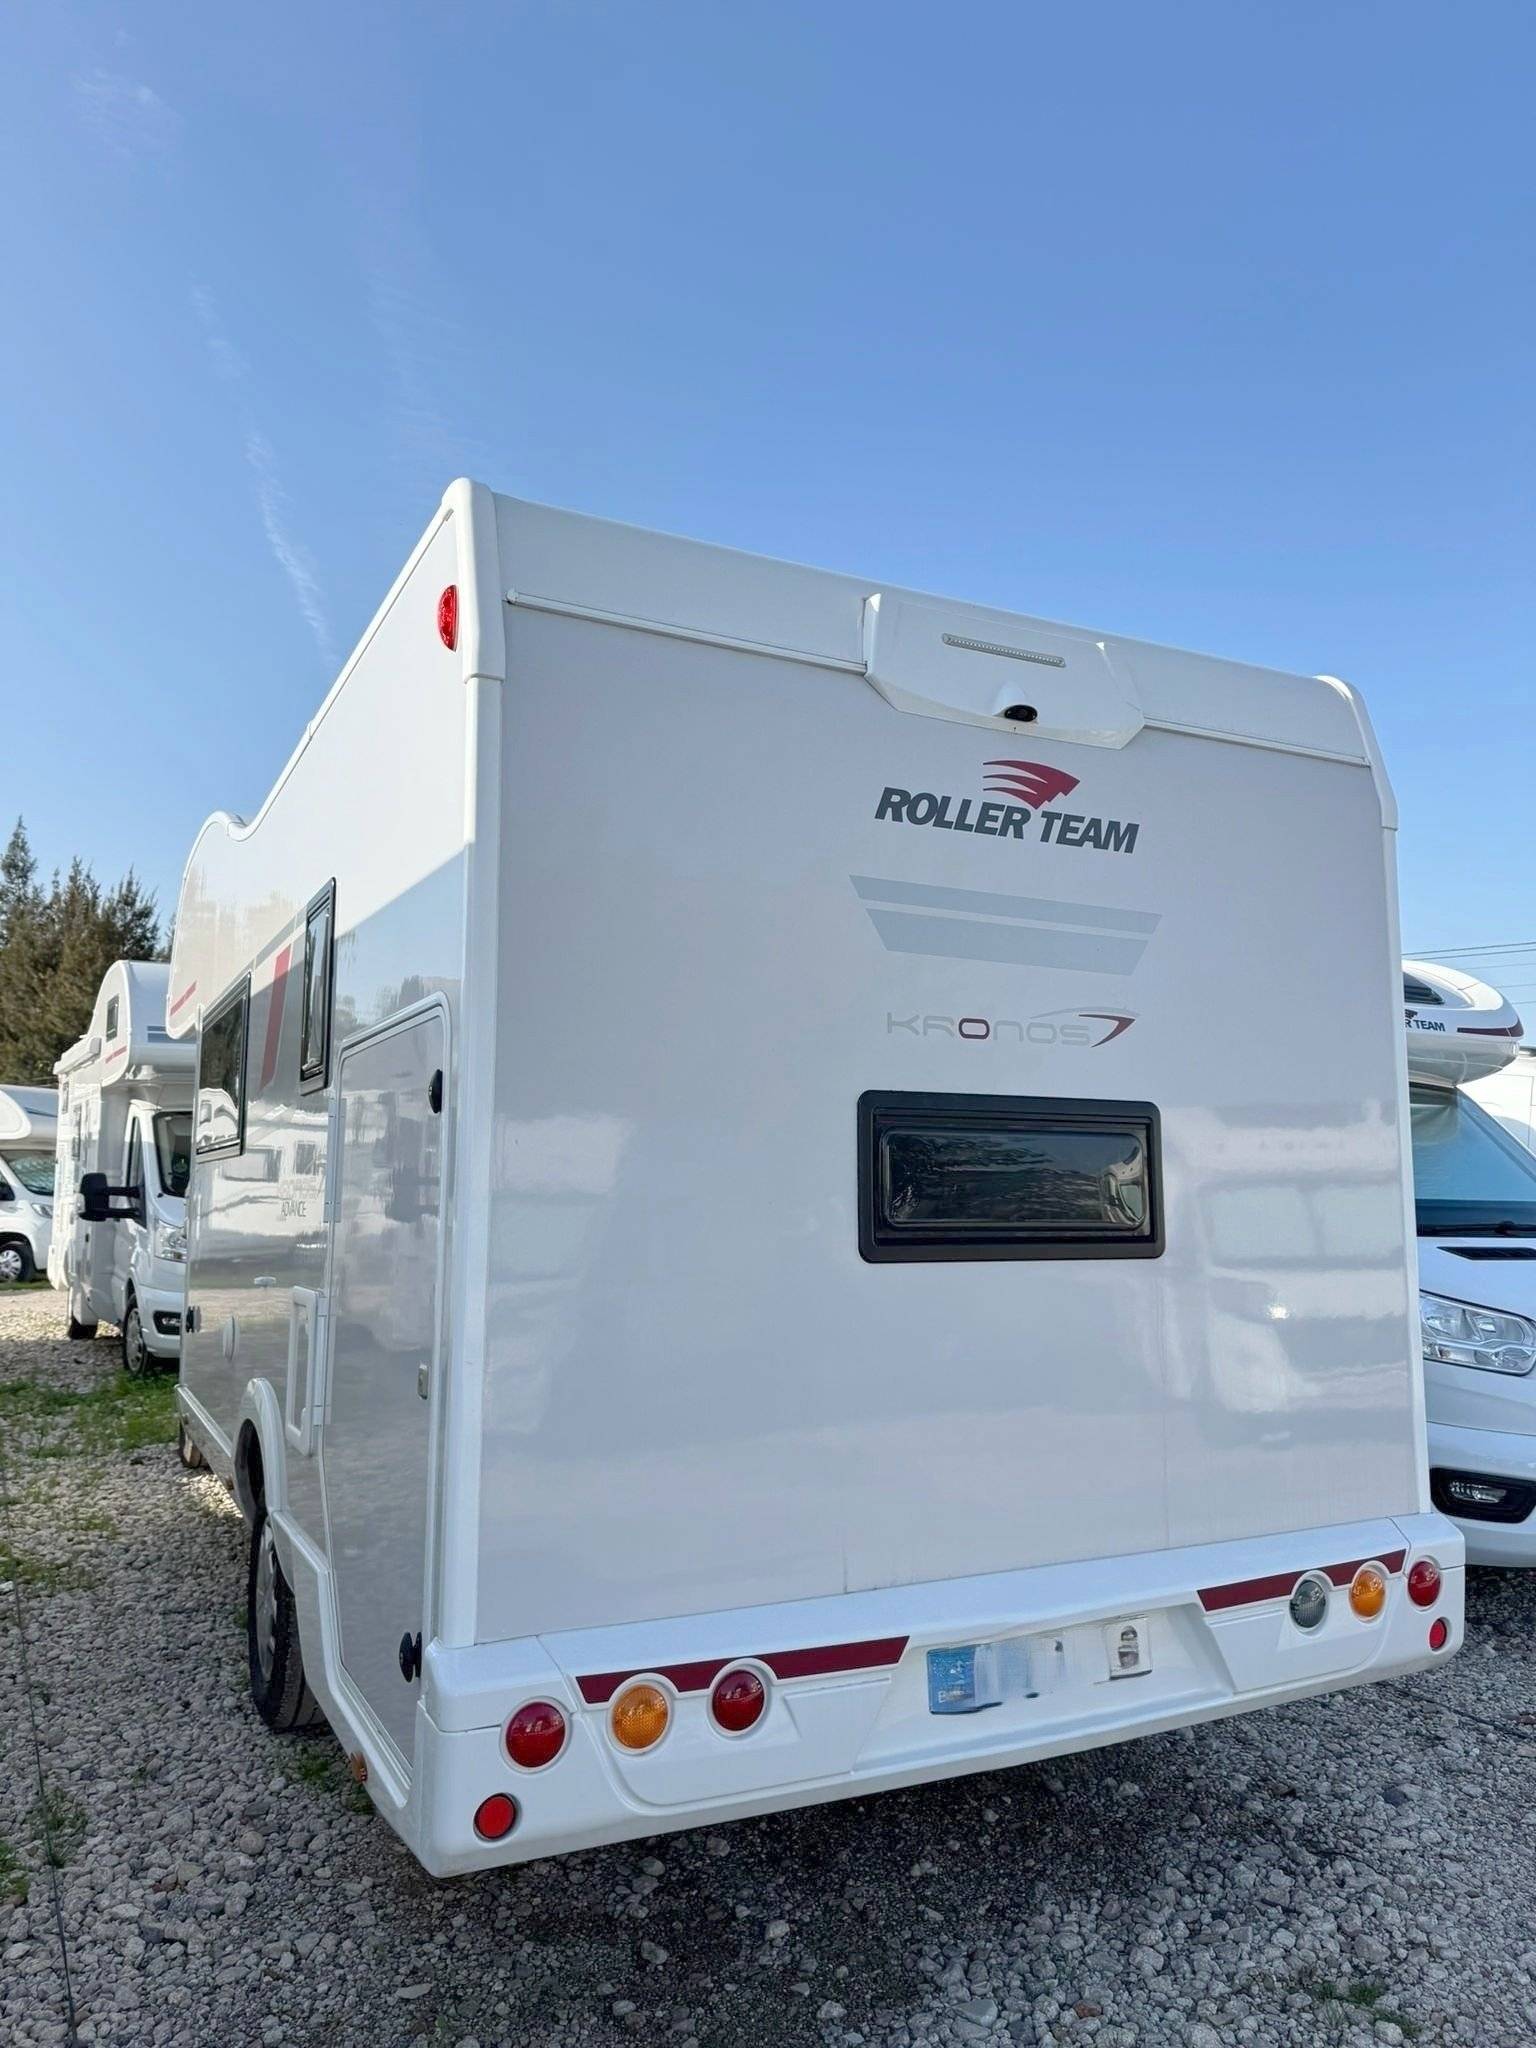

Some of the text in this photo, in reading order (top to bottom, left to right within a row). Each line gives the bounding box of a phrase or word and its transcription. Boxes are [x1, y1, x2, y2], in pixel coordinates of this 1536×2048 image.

[875, 786, 1140, 854] ROLLER TEAM
[1413, 1019, 1446, 1032] TEAM
